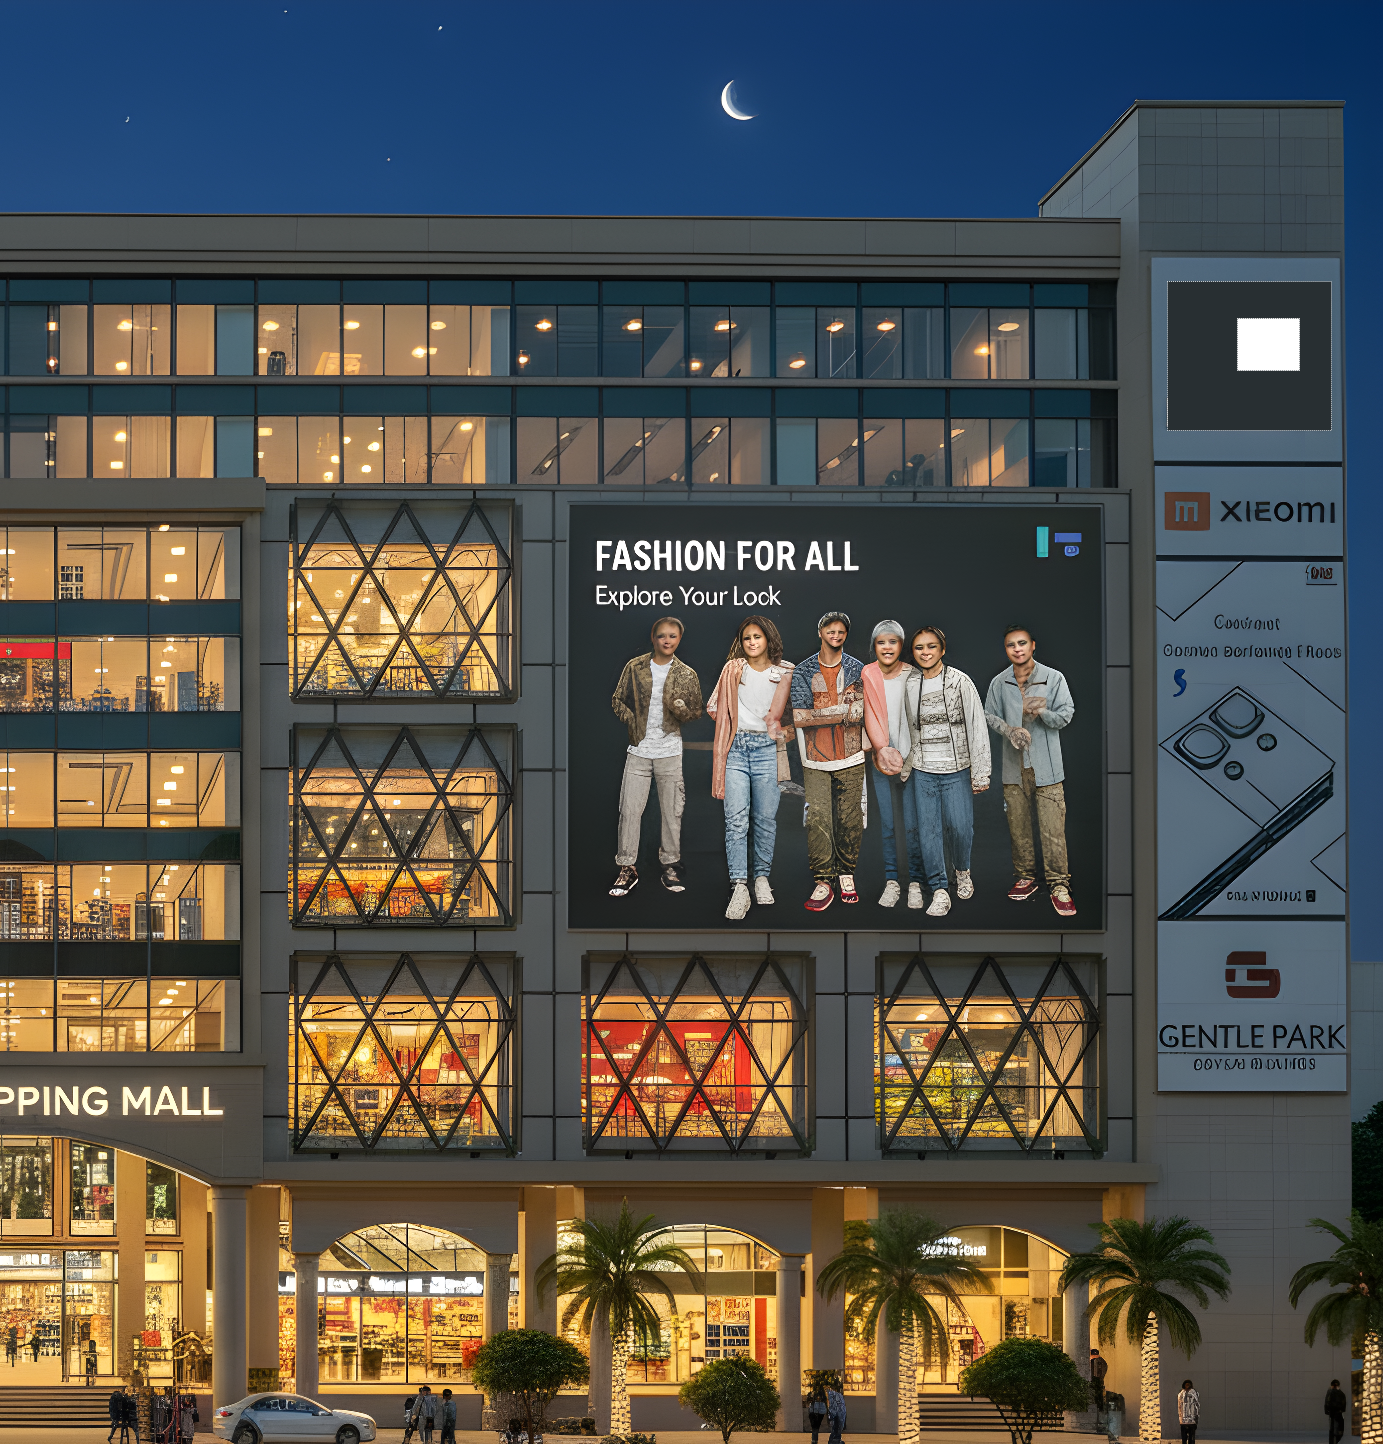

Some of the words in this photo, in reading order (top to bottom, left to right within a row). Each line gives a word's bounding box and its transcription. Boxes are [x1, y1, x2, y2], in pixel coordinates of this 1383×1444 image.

[595, 539, 726, 572] FASHION
[737, 539, 796, 572] FOR
[804, 539, 860, 572] ALL
[595, 584, 674, 612] Explore
[678, 585, 728, 607] Your
[1159, 1024, 1265, 1048] GENTLE
[1272, 1024, 1347, 1049] PARK
[121, 1086, 224, 1116] MALL
